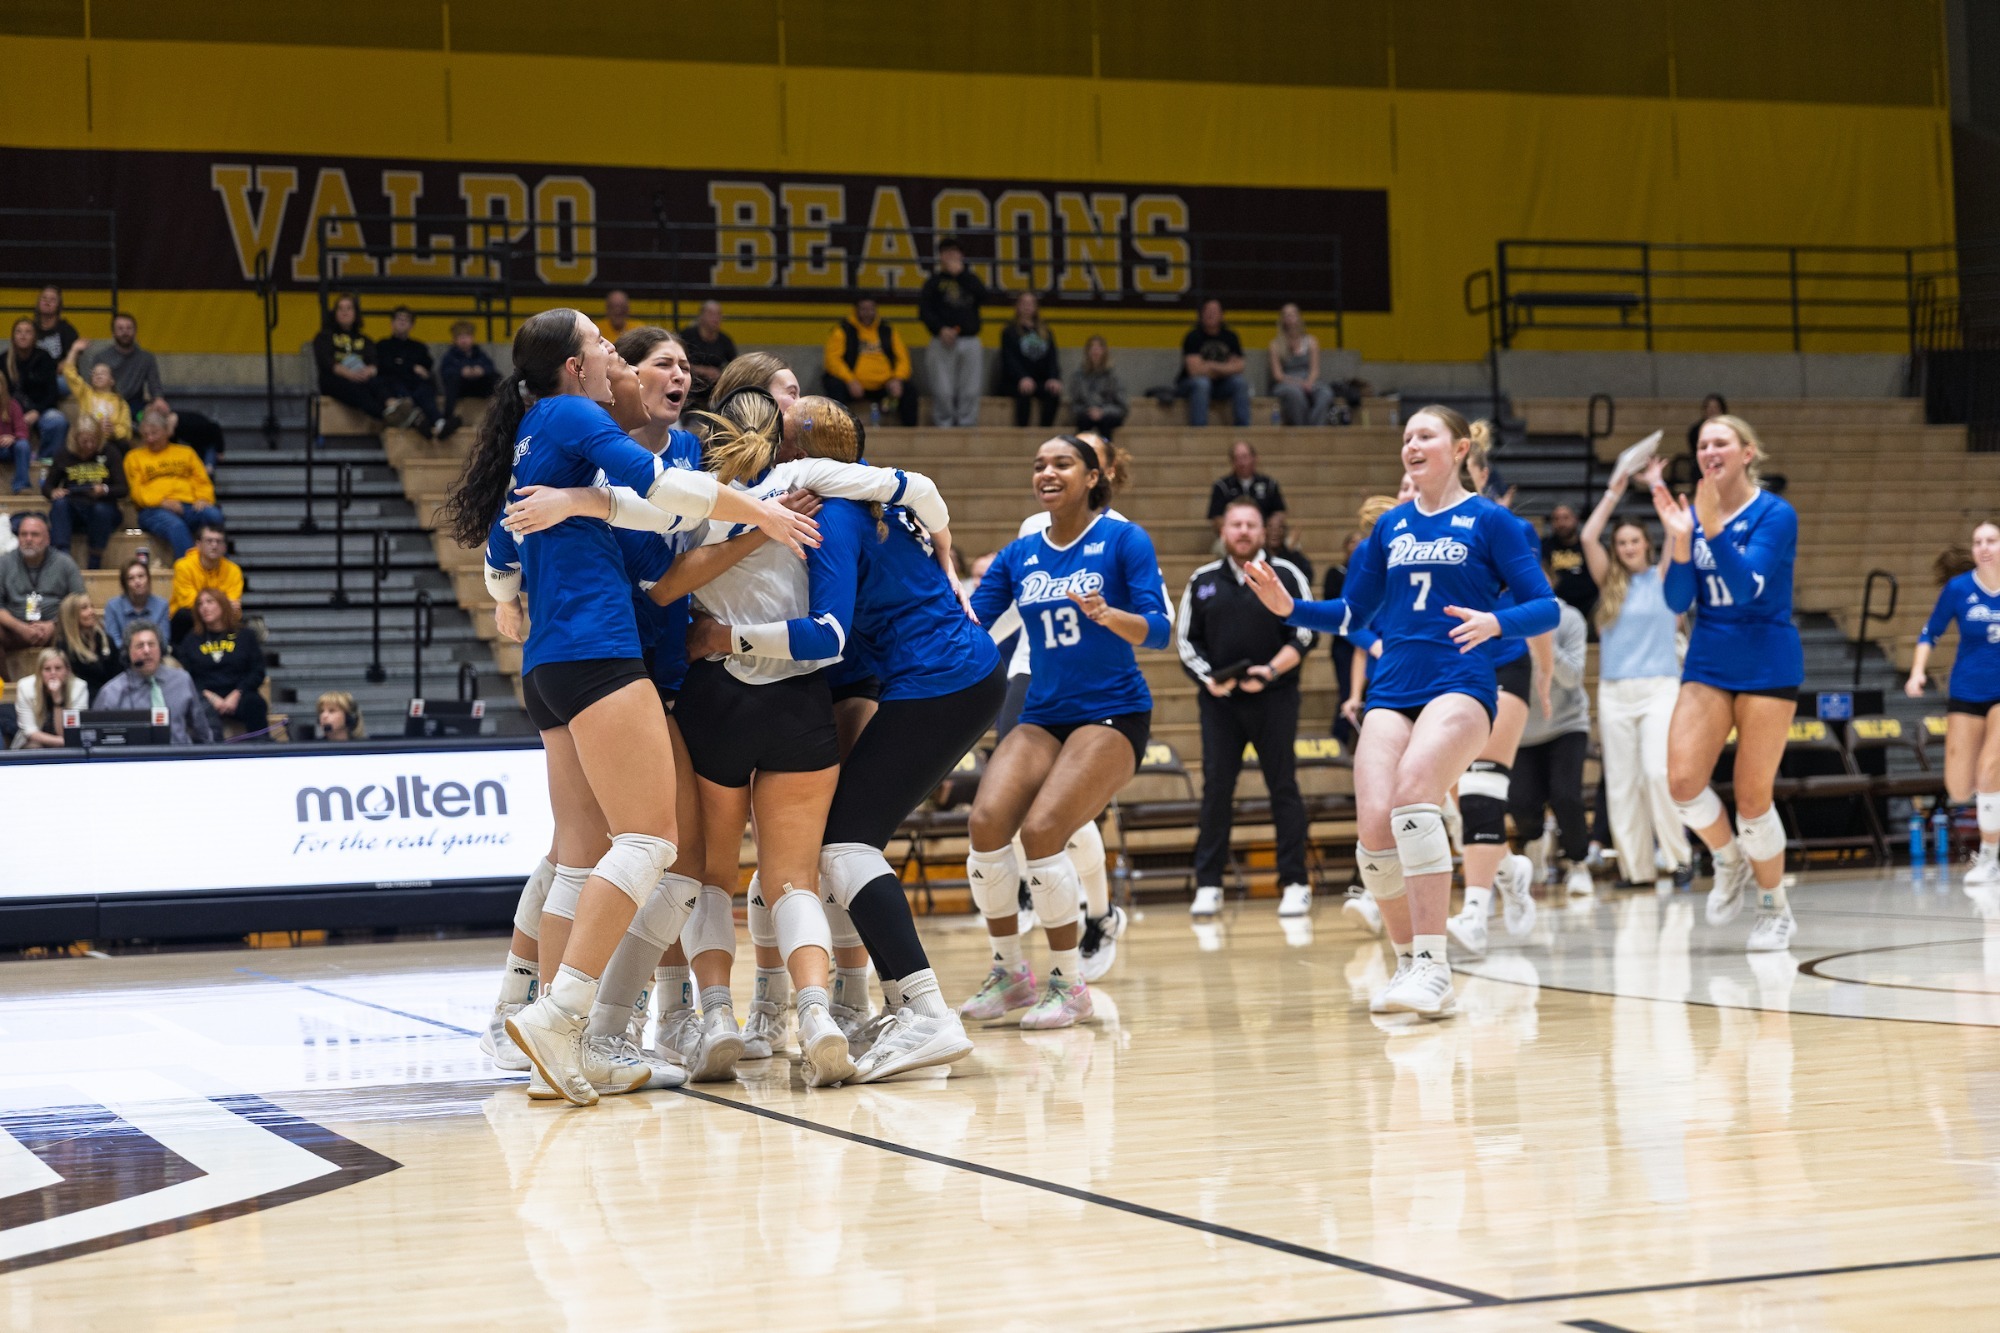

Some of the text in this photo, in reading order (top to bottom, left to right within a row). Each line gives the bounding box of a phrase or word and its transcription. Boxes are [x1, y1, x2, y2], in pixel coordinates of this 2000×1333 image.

[211, 163, 1190, 300] VALPO BEACONS
[1387, 533, 1469, 570] Drake
[1018, 568, 1104, 606] Drake
[1410, 571, 1432, 612] 7
[1040, 606, 1082, 649] 13
[296, 775, 508, 822] molten
[292, 827, 512, 856] For the real game
